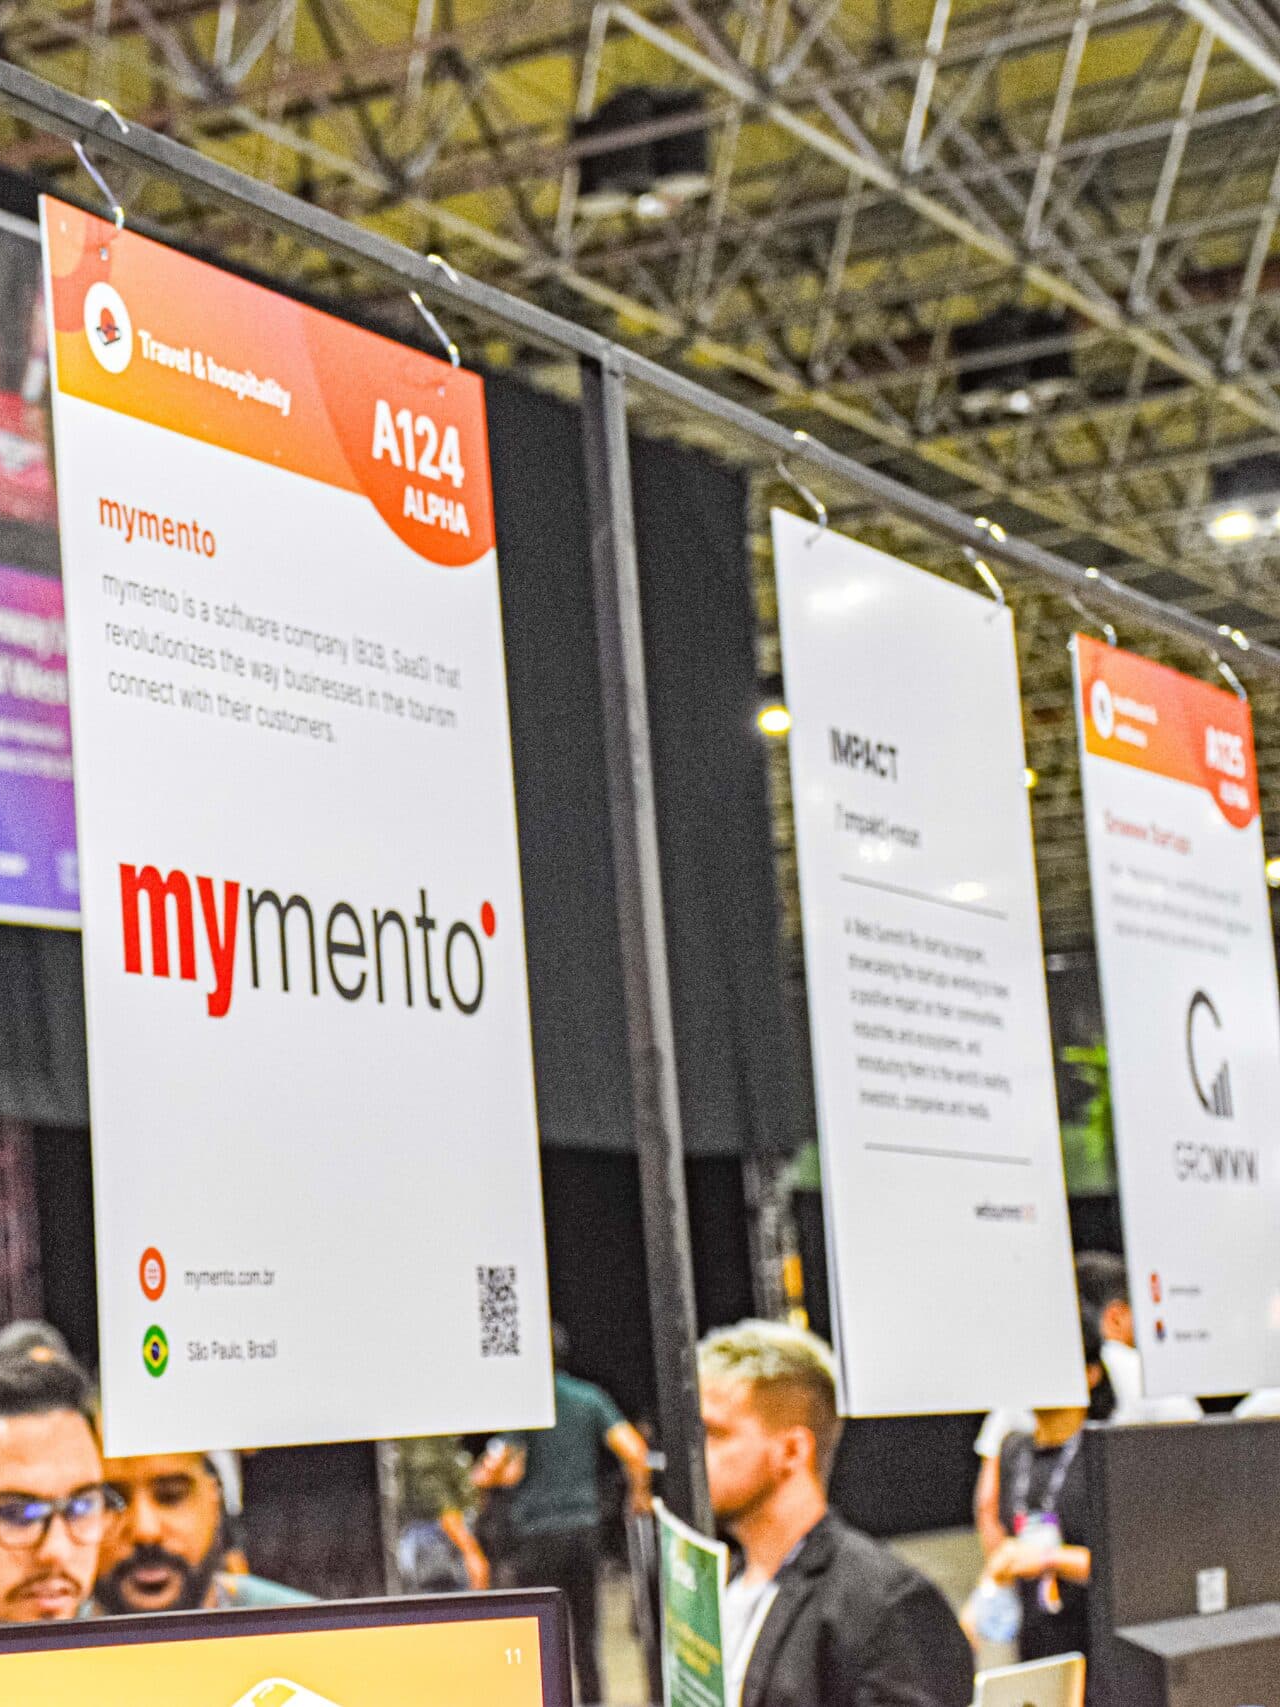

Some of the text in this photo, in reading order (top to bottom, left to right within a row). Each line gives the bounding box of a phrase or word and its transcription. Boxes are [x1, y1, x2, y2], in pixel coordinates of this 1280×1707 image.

[137, 329, 291, 417] Travel & hospitality
[371, 400, 465, 489] A124
[98, 496, 217, 559] mymento
[403, 485, 470, 538] ALPHA
[103, 574, 179, 614] mymento
[182, 590, 196, 619] is
[200, 601, 211, 623] a
[214, 601, 280, 642] software
[284, 624, 348, 665] company
[105, 621, 217, 670] revolutionizes
[220, 648, 245, 678] the
[250, 660, 280, 691] way
[284, 663, 364, 707] businesses
[108, 670, 175, 706] connect
[180, 685, 214, 714] with
[218, 692, 252, 724] their
[118, 862, 496, 1019] mymento
[504, 1647, 521, 1665] 11
